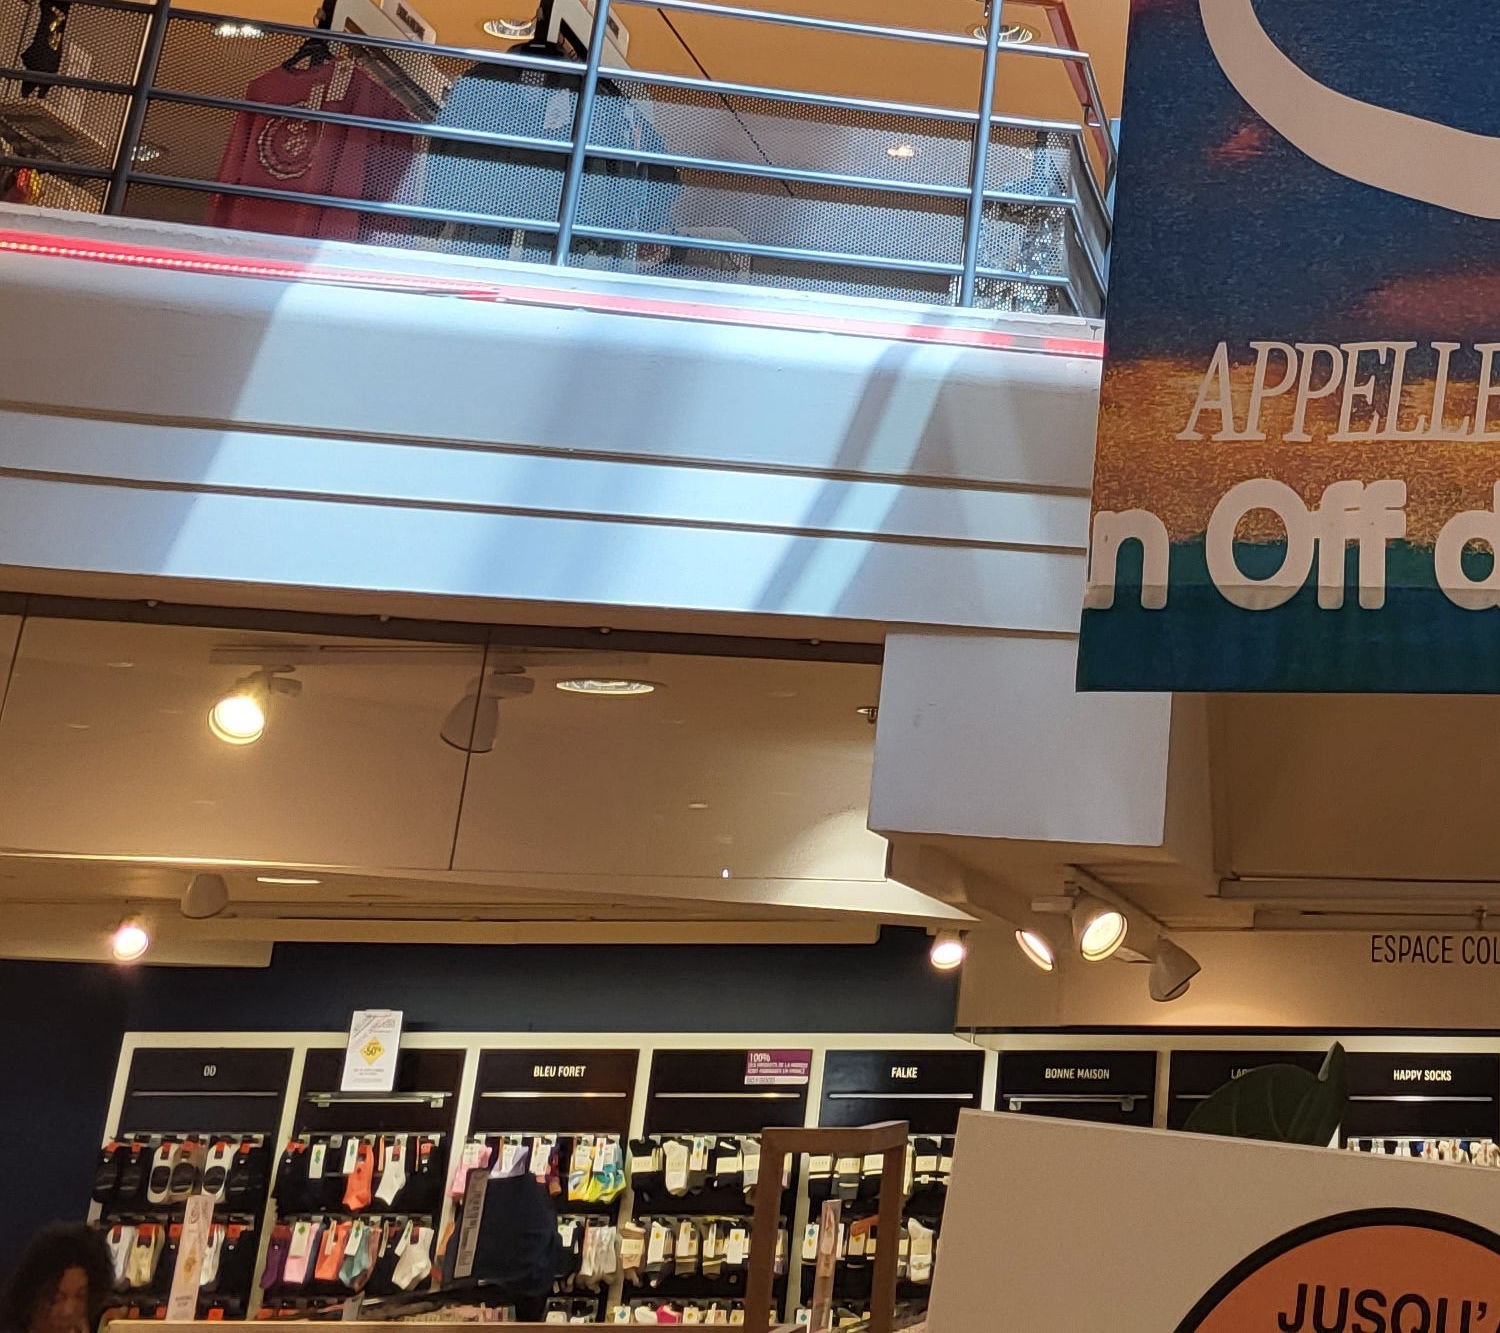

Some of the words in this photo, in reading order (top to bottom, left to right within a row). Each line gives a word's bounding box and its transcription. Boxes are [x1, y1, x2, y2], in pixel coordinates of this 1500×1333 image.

[1205, 477, 1407, 611] Off
[1370, 934, 1454, 964] ESPACE
[749, 1052, 771, 1062] 100%
[533, 1065, 557, 1078] BLEU
[558, 1065, 587, 1078] FORET
[891, 1066, 918, 1079] FALKE
[1044, 1067, 1075, 1080] BONNE
[1077, 1068, 1110, 1080] MAISON
[1393, 1069, 1422, 1081] HAPPY
[1423, 1070, 1452, 1082] SOCKS
